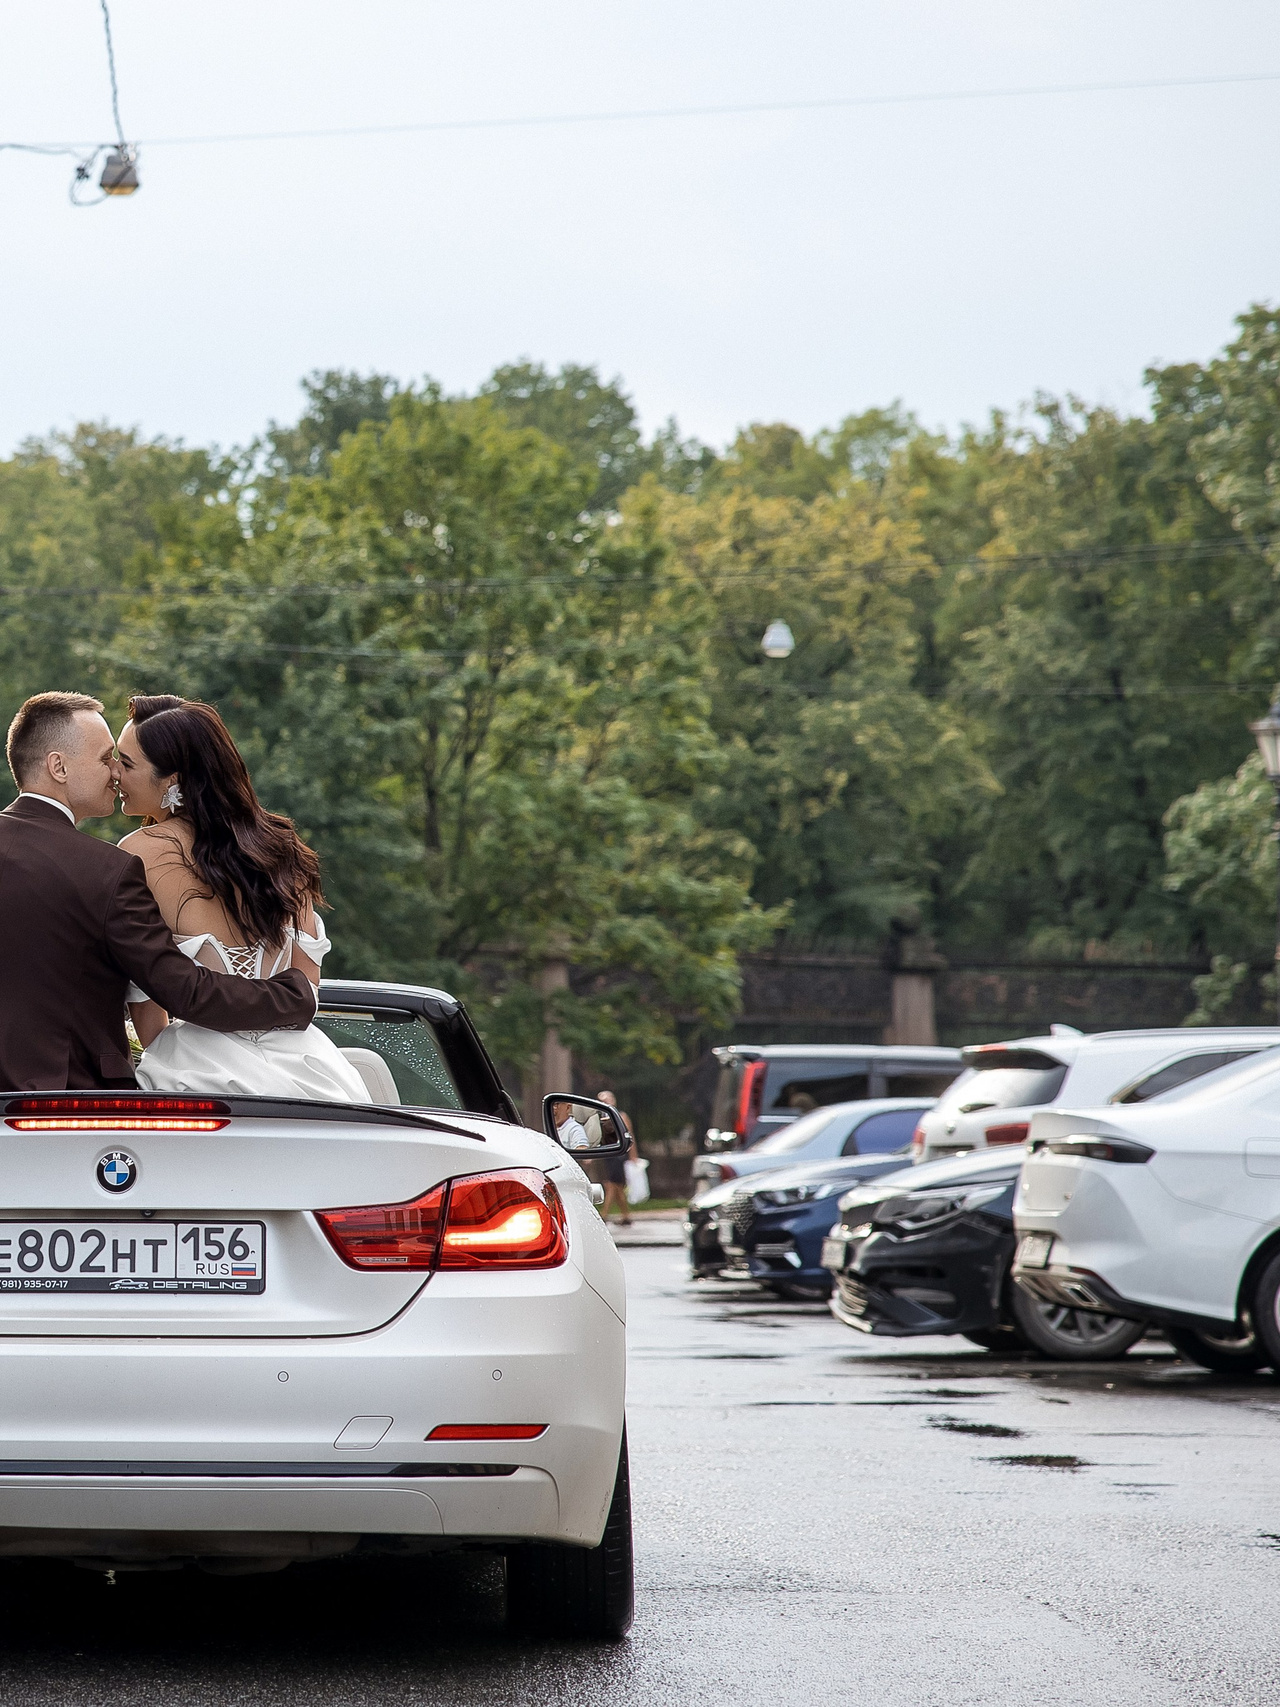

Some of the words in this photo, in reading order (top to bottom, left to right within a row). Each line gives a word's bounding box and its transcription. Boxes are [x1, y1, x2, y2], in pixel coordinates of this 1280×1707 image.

[100, 1152, 134, 1166] BMW
[181, 1227, 250, 1261] 156
[195, 1263, 230, 1275] RUS
[23, 1280, 68, 1288] 935-07-17
[152, 1280, 248, 1290] DETAILING
